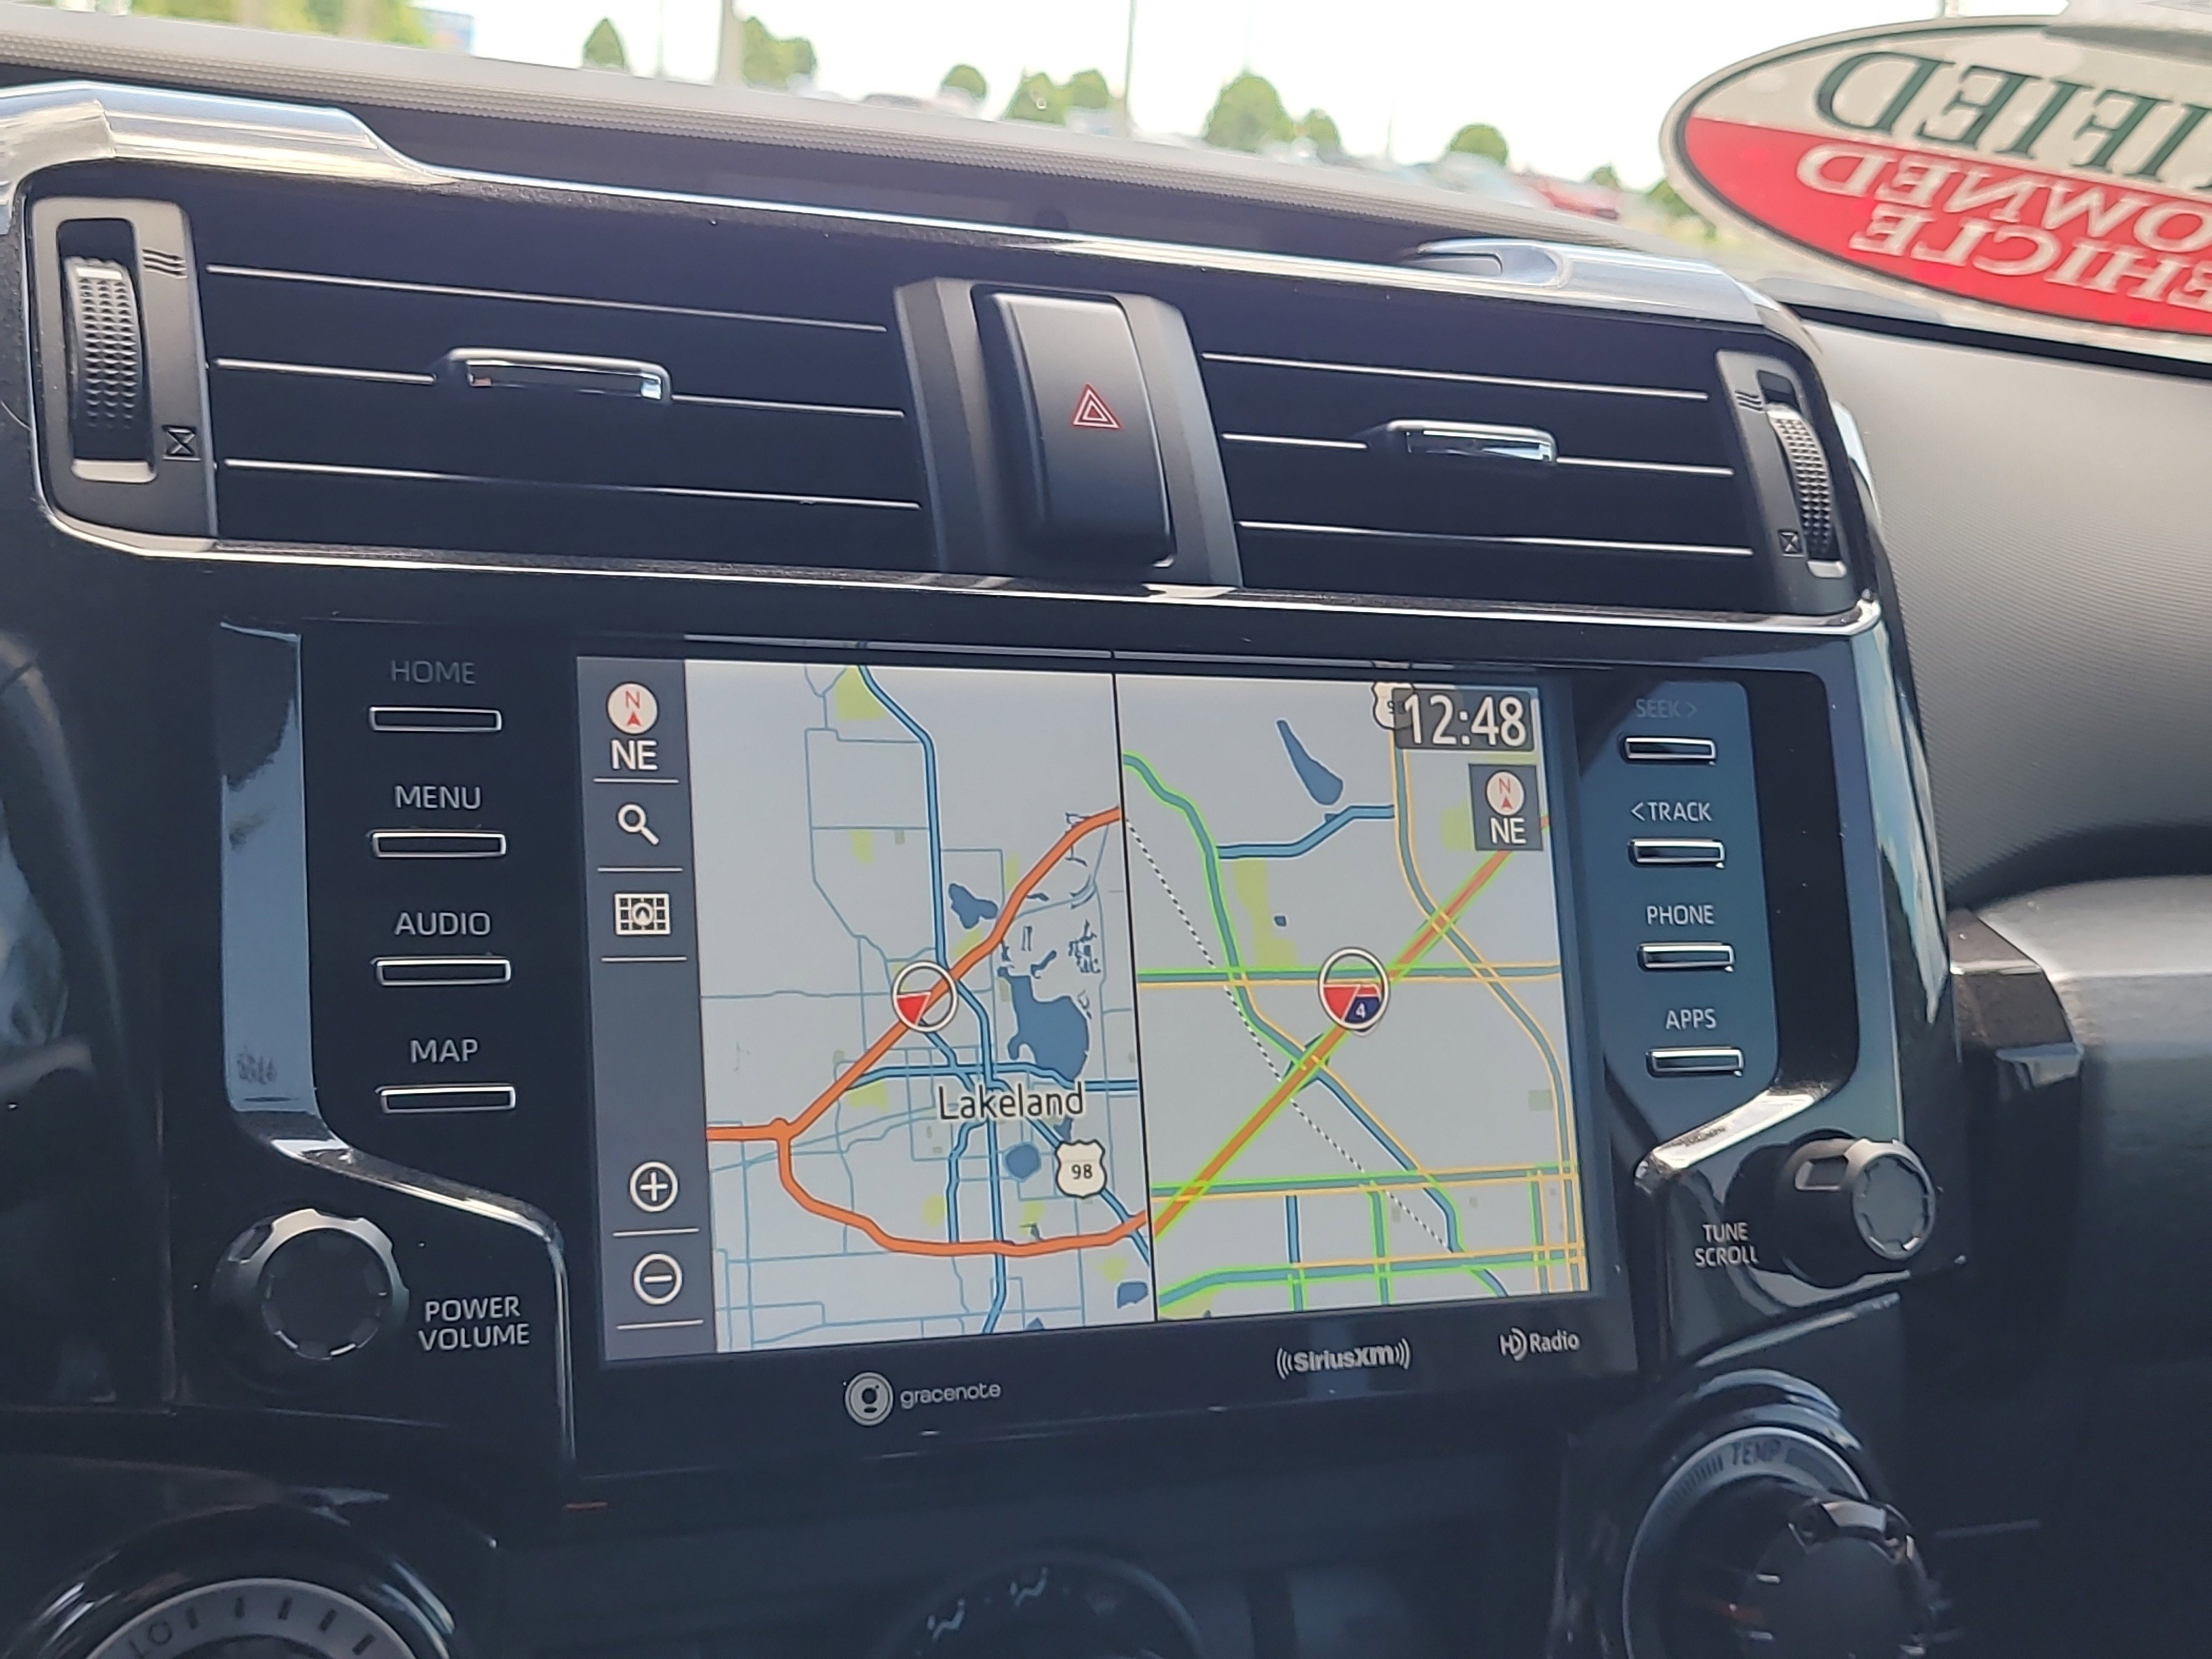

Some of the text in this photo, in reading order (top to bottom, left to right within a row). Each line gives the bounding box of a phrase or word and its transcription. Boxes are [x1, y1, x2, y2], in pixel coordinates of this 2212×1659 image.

[391, 660, 476, 685] HOME
[625, 691, 640, 709] N
[1404, 693, 1527, 747] 12:48
[611, 739, 658, 770] NE
[394, 785, 482, 809] MENU
[1498, 777, 1511, 794] N
[1489, 817, 1527, 844] NE
[394, 911, 492, 935] AUDIO
[1646, 904, 1715, 926] PHONE
[1355, 1002, 1366, 1019] 4
[1665, 1008, 1718, 1030] APPS
[410, 1039, 479, 1063] MAP
[938, 1081, 1085, 1120] Lakeland
[1071, 1163, 1093, 1180] 98
[1702, 1222, 1750, 1243] TUNE
[1694, 1246, 1759, 1268] SCROLL
[425, 1296, 521, 1323] POWER
[417, 1323, 530, 1351] VOLUME
[1529, 1329, 1581, 1353] Radio
[900, 1382, 1002, 1409] gracenote
